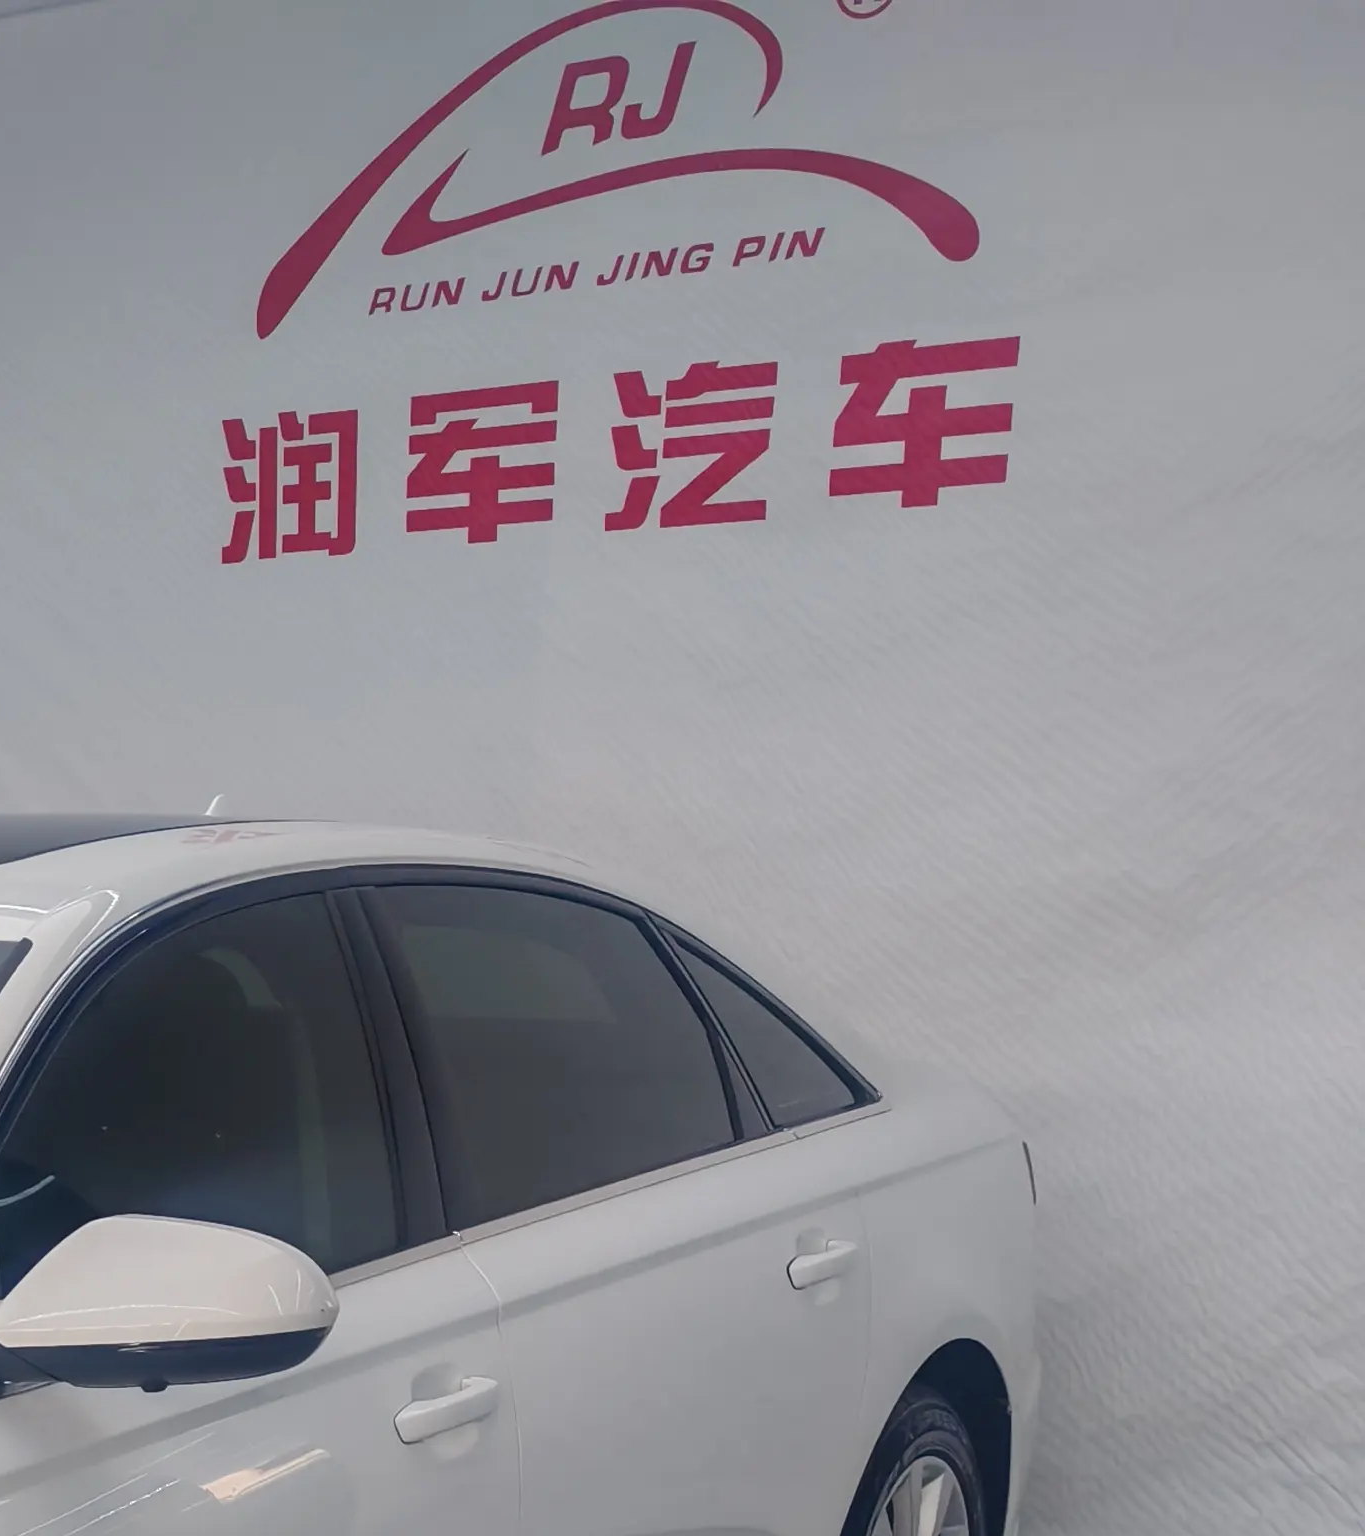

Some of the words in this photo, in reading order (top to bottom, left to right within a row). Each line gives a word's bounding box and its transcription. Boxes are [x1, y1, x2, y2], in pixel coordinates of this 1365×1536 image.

[541, 40, 698, 157] RJ
[368, 277, 466, 316] RUN
[481, 261, 580, 302] JUN
[596, 242, 715, 287] JING
[732, 227, 826, 267] PIN
[221, 335, 1021, 565] 润军汽车
